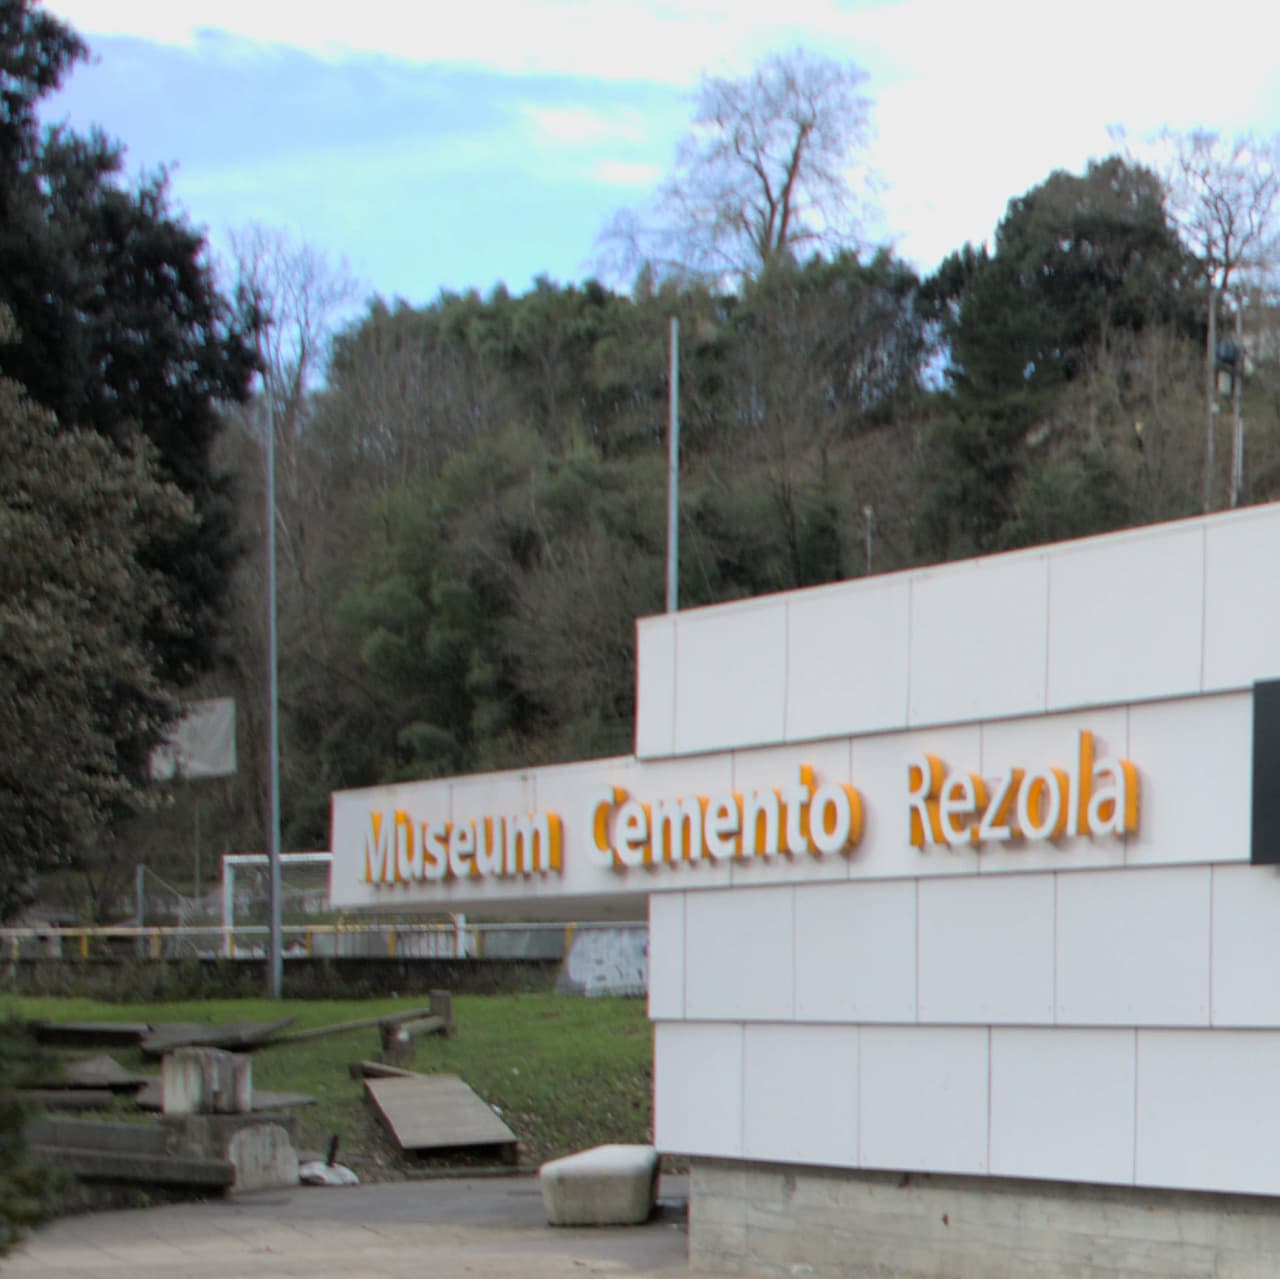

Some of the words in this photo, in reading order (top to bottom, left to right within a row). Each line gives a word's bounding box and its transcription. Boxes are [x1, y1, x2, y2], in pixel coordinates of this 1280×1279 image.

[363, 809, 563, 886] Museum
[588, 764, 866, 869] Cemento
[907, 729, 1139, 848] Rezola
